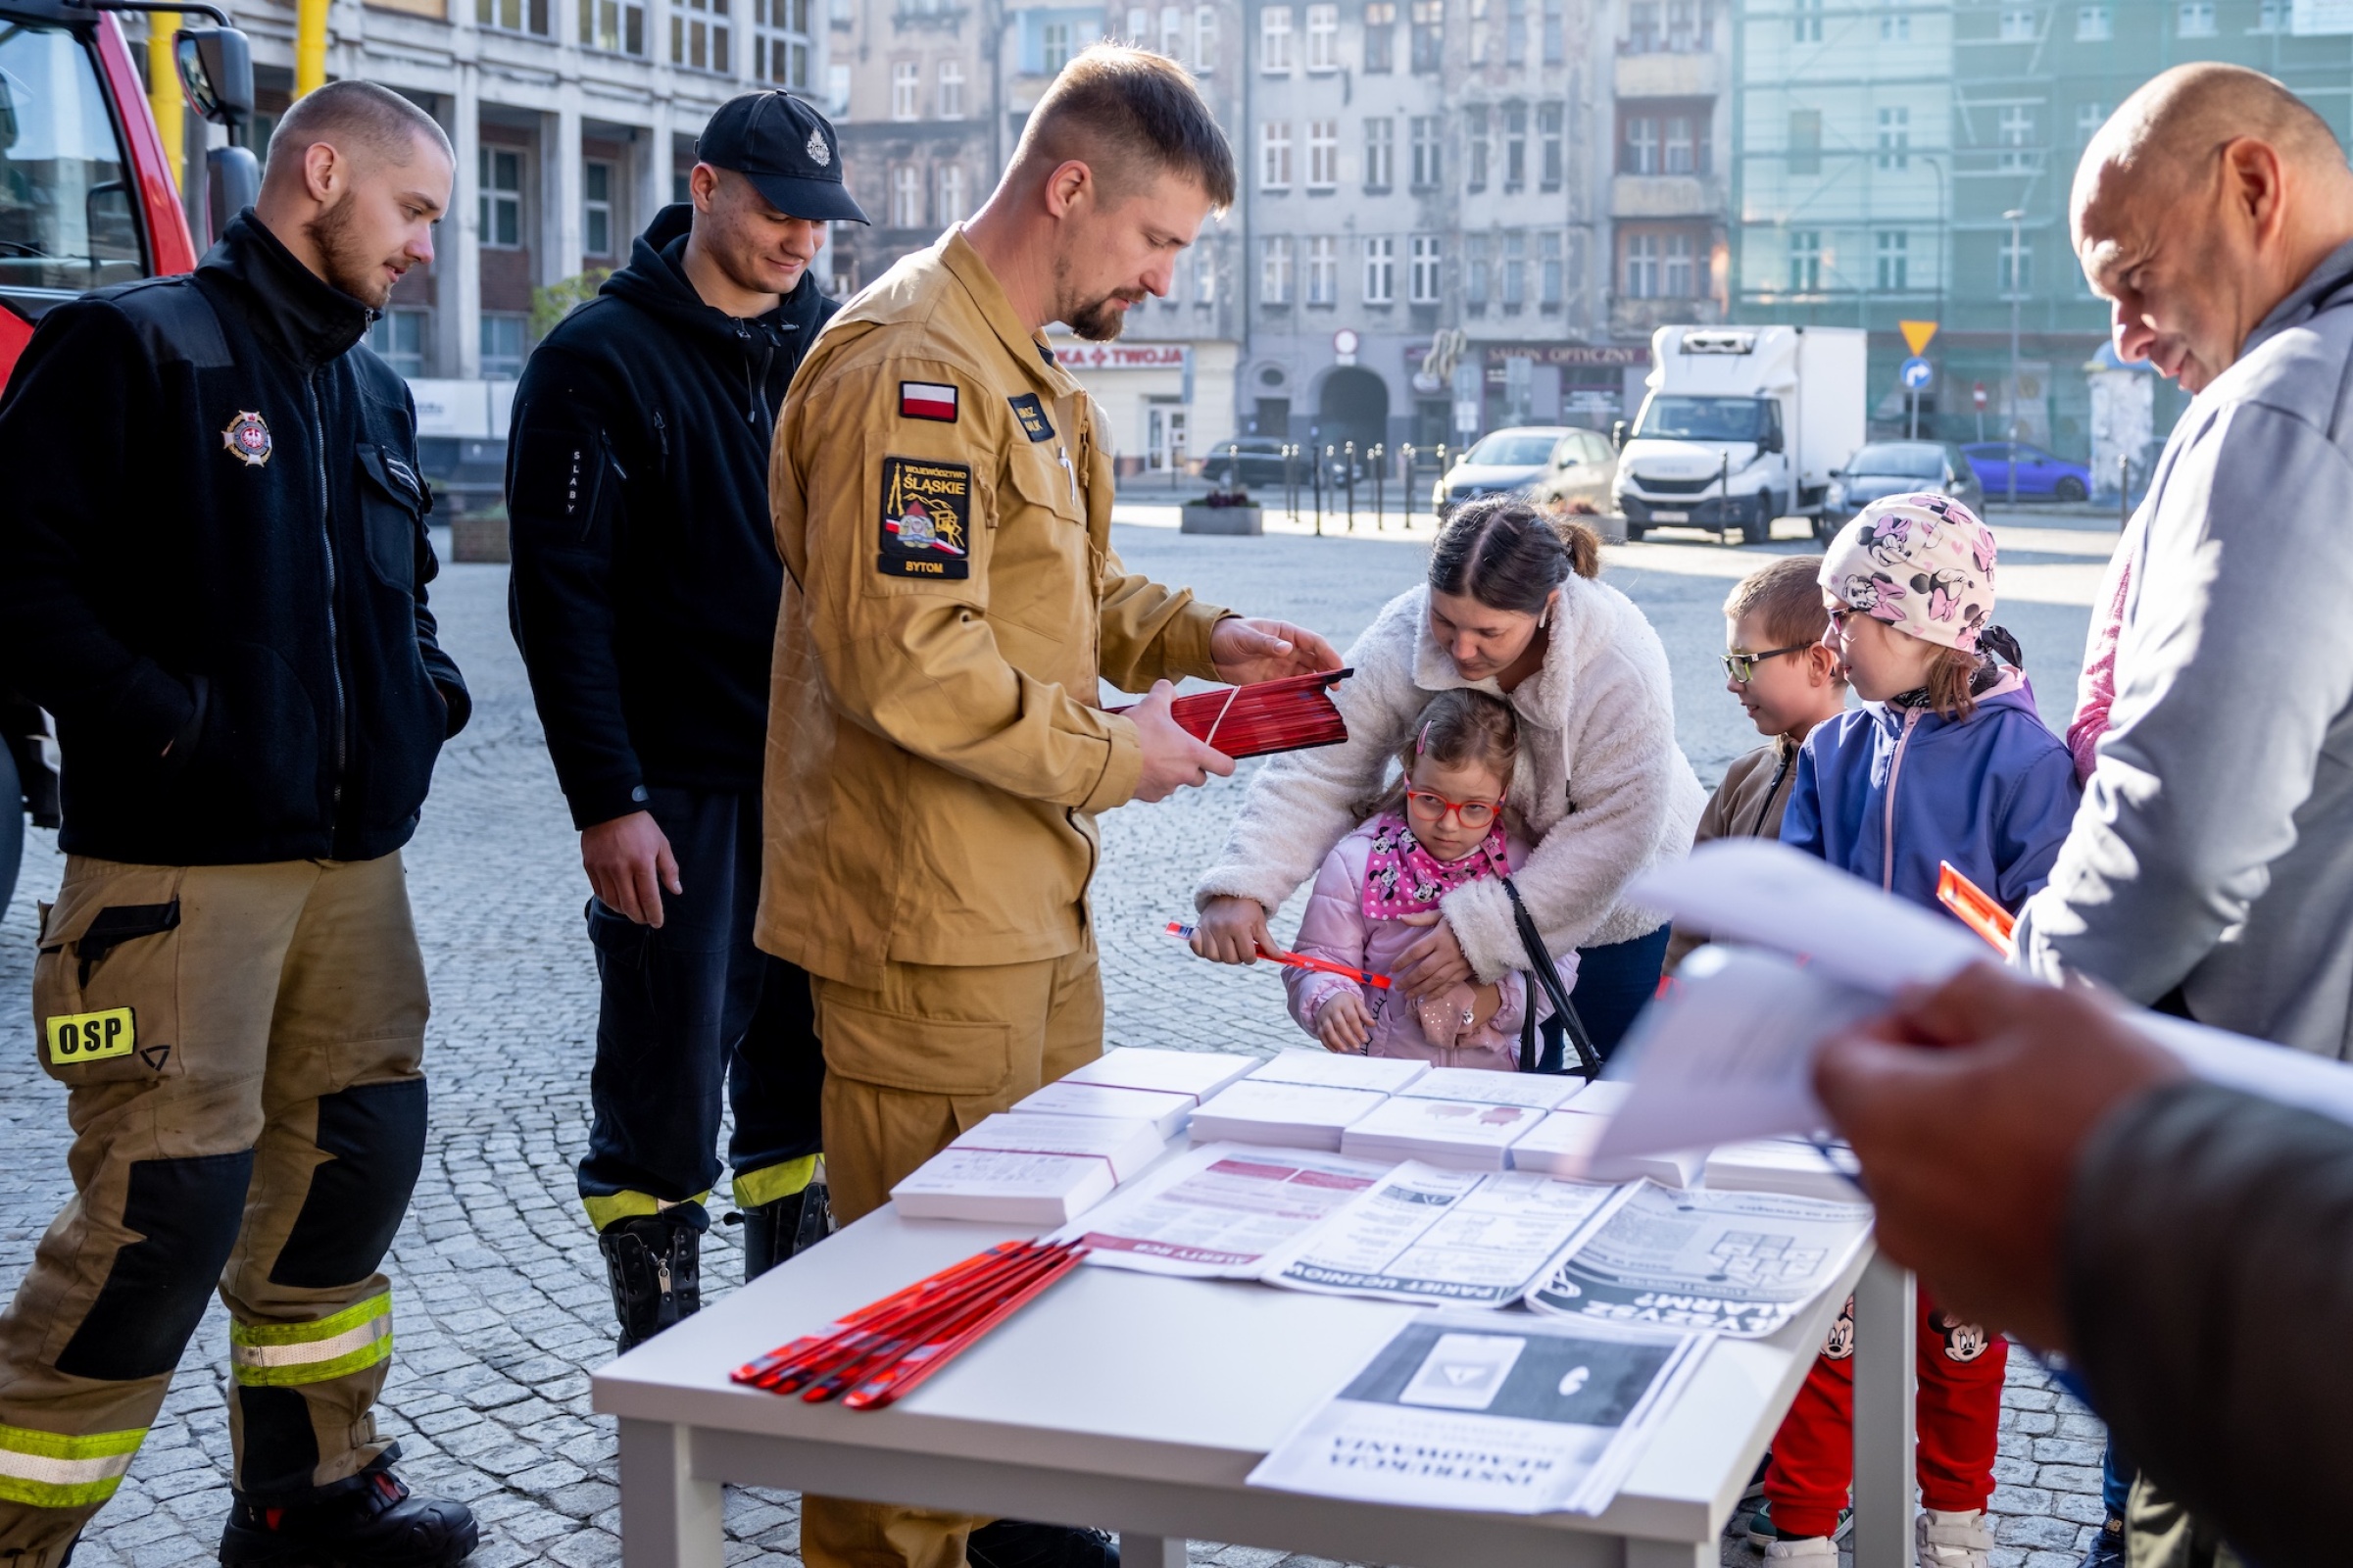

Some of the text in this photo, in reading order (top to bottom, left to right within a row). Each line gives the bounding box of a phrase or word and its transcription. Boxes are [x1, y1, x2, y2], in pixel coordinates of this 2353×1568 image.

[1111, 348, 1184, 365] TWOJA
[1548, 347, 1635, 364] OPTYCZNY
[566, 451, 581, 514] SLABY
[904, 464, 967, 480] WOJEWÓDZTWO
[902, 472, 966, 496] ŚLĄSKIE
[905, 560, 945, 574] BYTOM
[59, 1016, 122, 1055] OSP
[1402, 1279, 1495, 1298] PAKIET
[1334, 1438, 1553, 1472] REAGOWANIA
[1330, 1453, 1534, 1487] INSTRUKCJA
